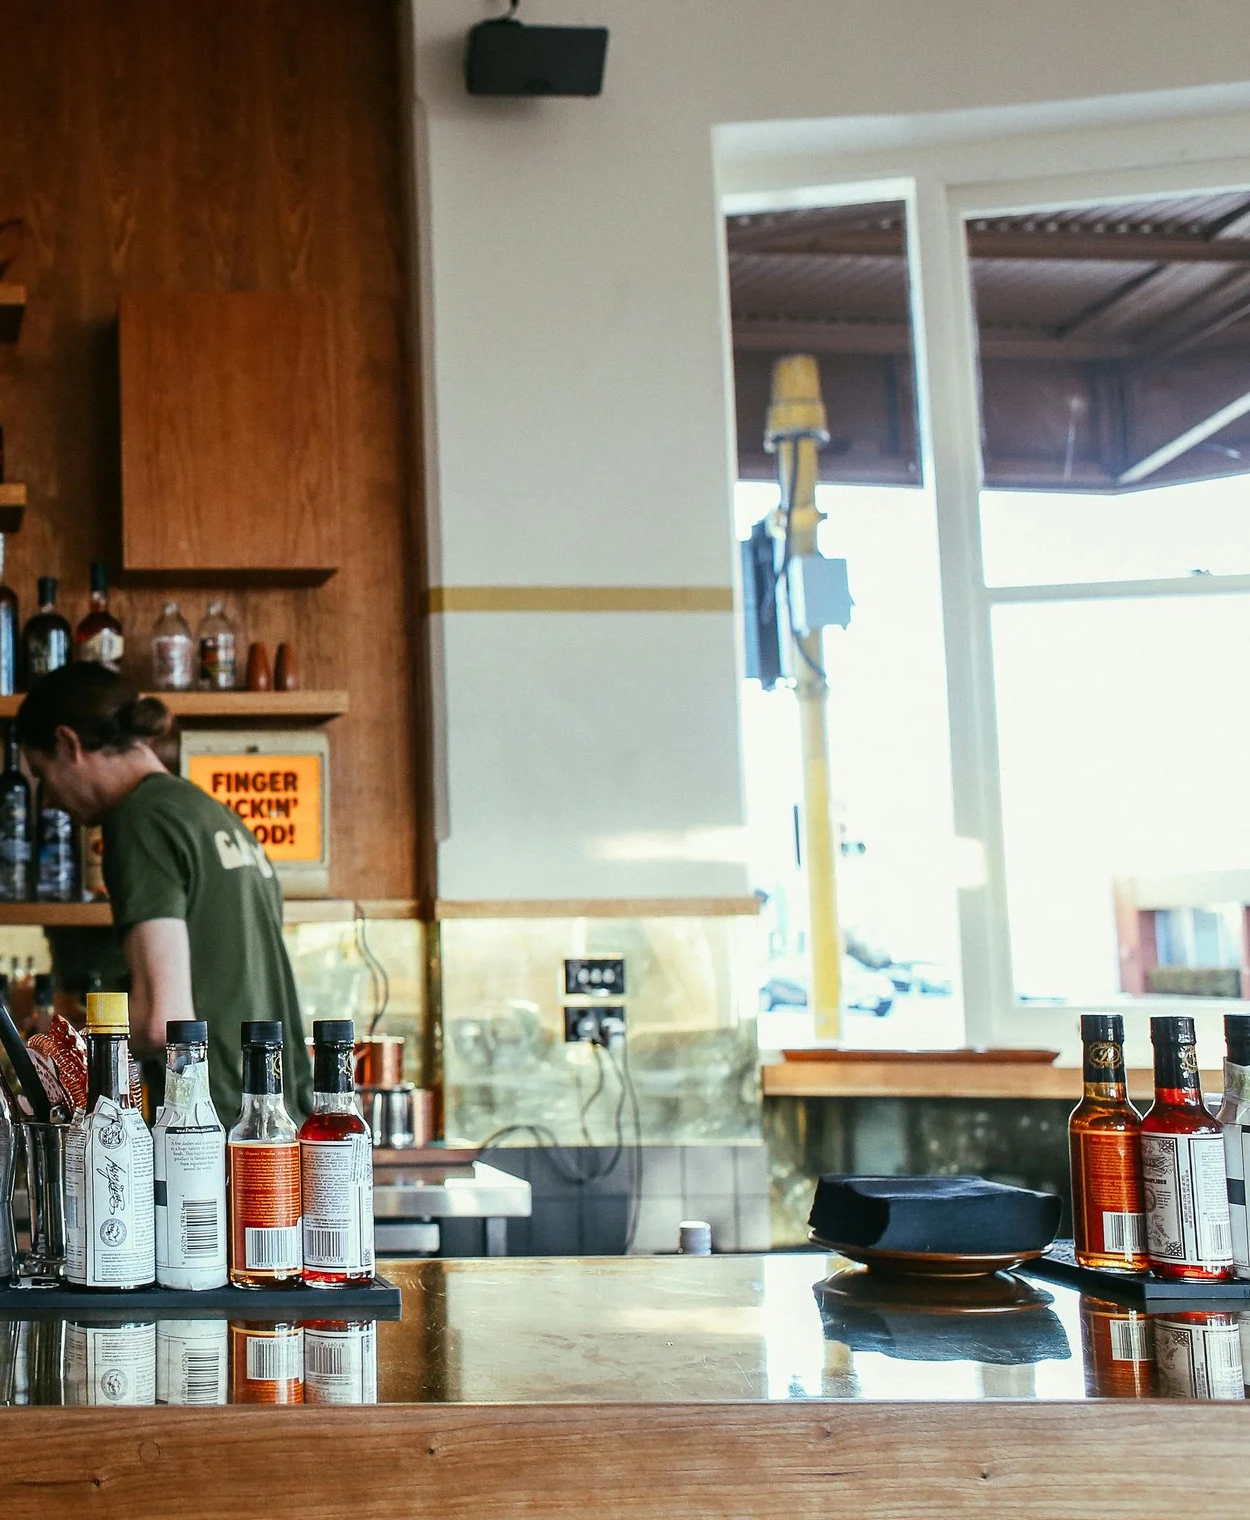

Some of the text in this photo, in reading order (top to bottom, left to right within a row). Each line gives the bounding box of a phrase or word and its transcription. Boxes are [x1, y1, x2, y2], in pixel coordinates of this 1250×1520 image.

[212, 772, 298, 793] FINGER
[226, 798, 298, 818] CKIN'
[254, 824, 294, 844] OD!
